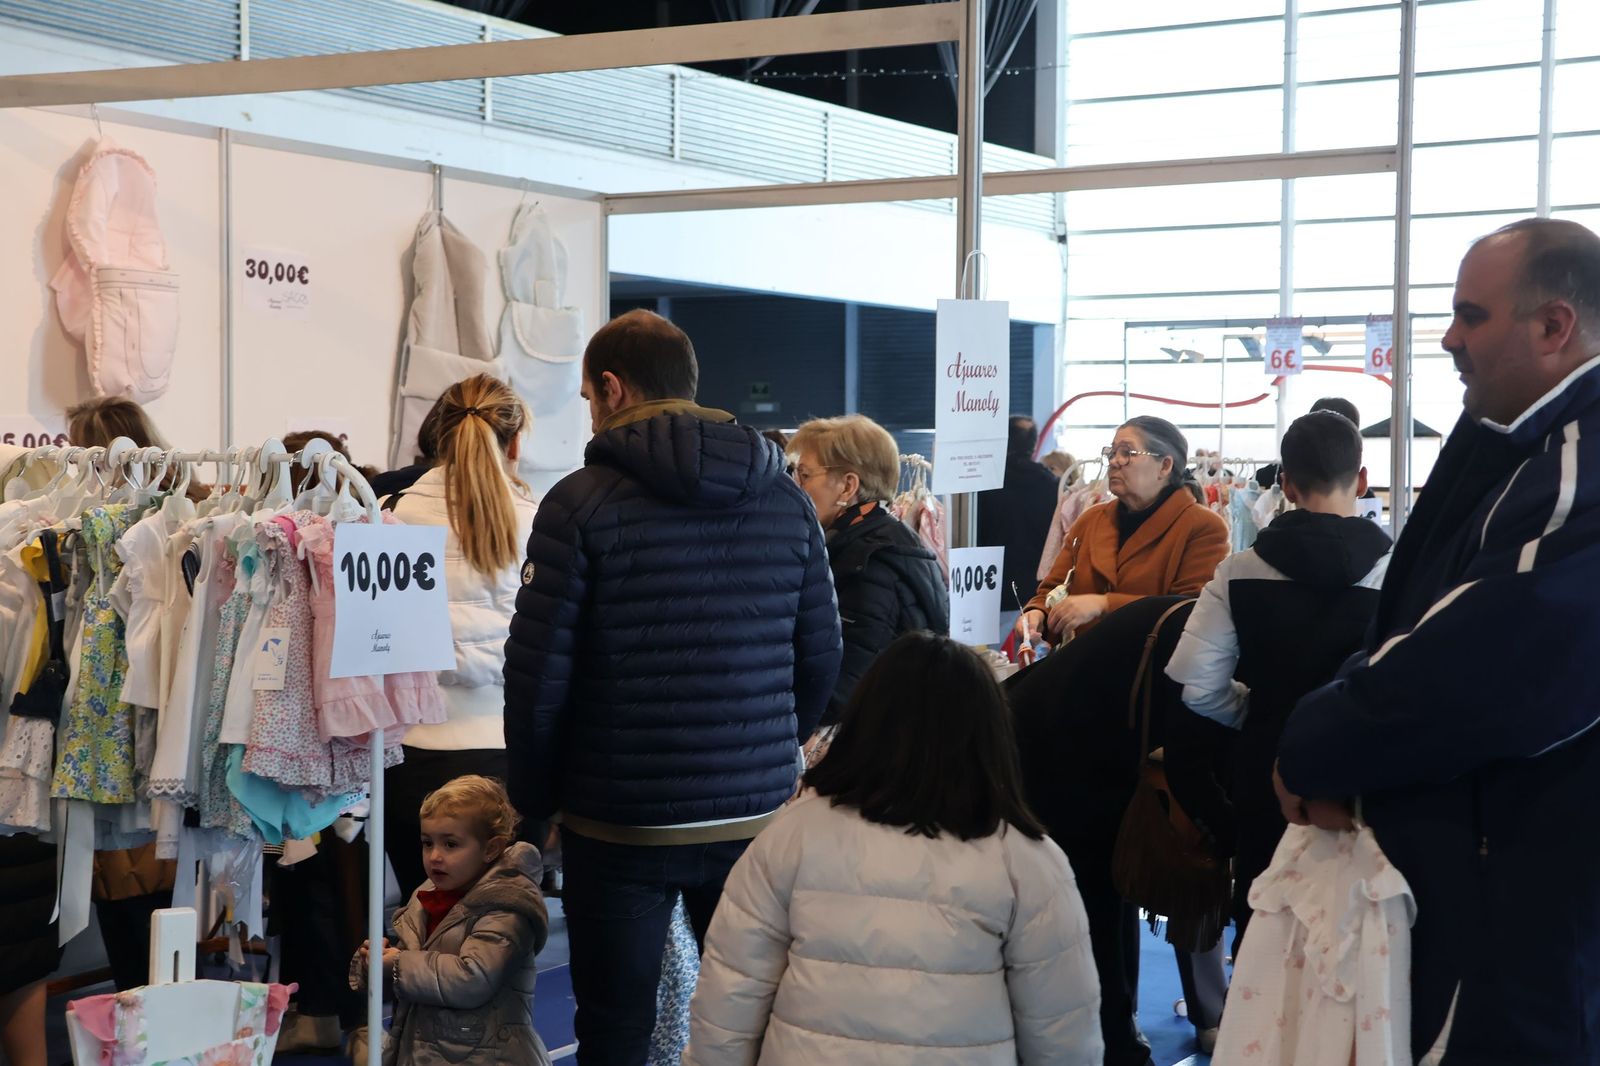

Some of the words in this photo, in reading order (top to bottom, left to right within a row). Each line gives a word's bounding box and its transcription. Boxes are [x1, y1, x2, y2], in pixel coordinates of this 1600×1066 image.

[245, 258, 309, 285] 30,00€
[947, 352, 998, 385] Ajuares
[1270, 349, 1296, 369] 6€
[951, 390, 1000, 418] Manoly
[341, 552, 436, 600] 10,00€
[951, 564, 997, 598] 10,00€
